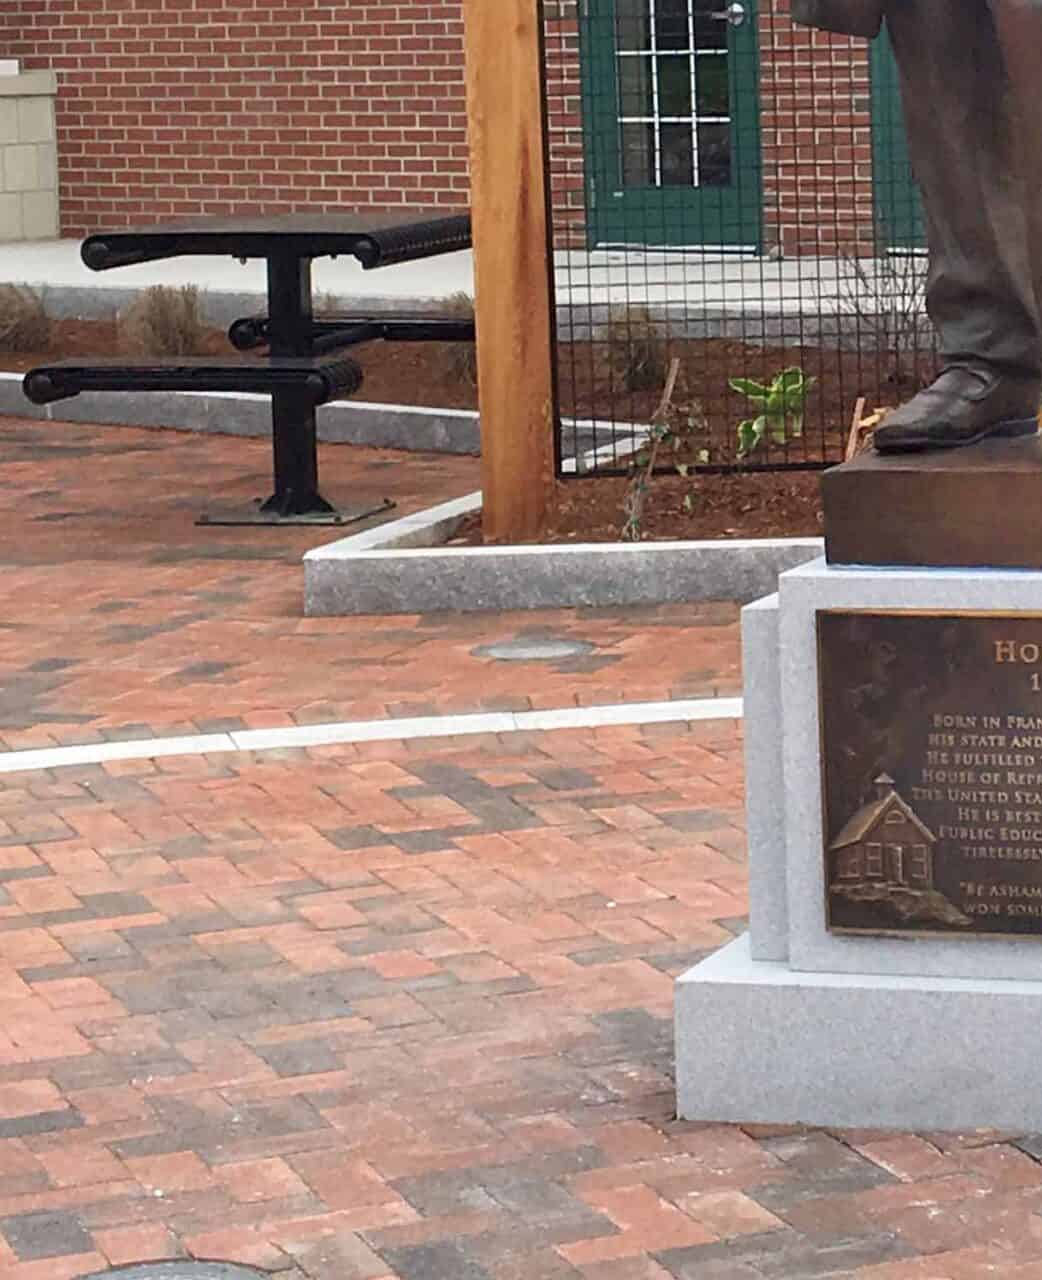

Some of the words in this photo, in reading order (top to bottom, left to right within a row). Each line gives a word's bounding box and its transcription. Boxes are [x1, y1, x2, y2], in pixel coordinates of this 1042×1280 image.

[933, 715, 976, 729] BORN
[983, 716, 1000, 729] IN
[928, 734, 954, 745] HIS
[960, 735, 1006, 747] STATE
[926, 751, 949, 764] HE
[954, 754, 1034, 766] FULFILLED
[921, 769, 976, 783] HOUSE
[980, 773, 1000, 784] OF
[912, 787, 943, 800] THE
[947, 788, 1008, 802] UNITED
[958, 807, 979, 820] HE
[986, 809, 999, 820] IS
[1006, 810, 1040, 822] BEST
[939, 825, 995, 840] PUBLIC
[964, 904, 999, 915] WON
